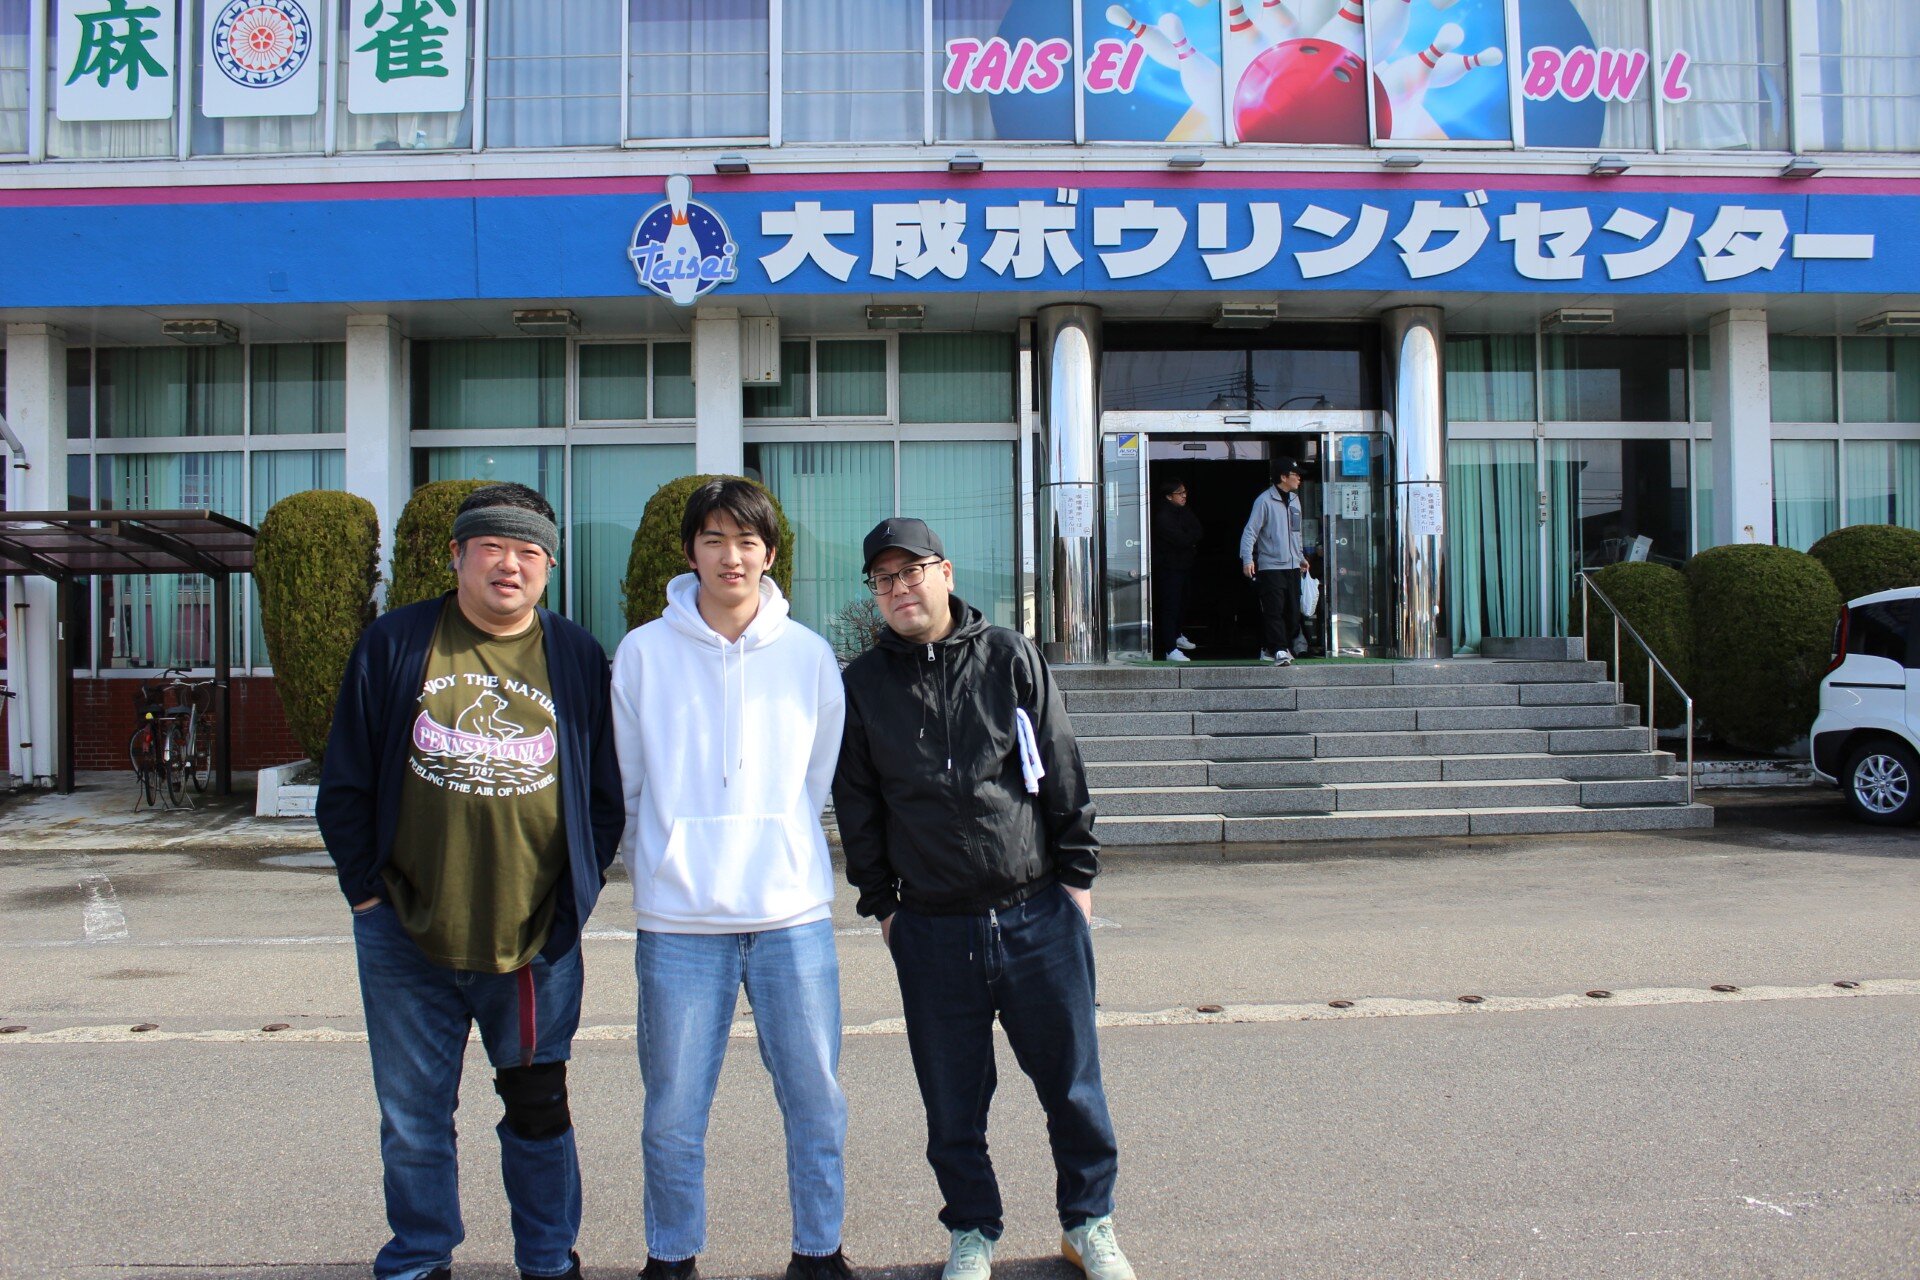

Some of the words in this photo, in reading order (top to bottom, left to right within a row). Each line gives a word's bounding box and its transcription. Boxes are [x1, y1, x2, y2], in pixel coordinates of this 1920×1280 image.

[64, 0, 169, 91] 麻
[354, 0, 457, 83] 雀
[758, 188, 1875, 284] 大成ボウリングセンター
[631, 241, 736, 281] Taisei
[463, 673, 499, 688] THE
[408, 755, 445, 787] FEELING
[447, 780, 471, 793] THE
[474, 786, 494, 797] AIR
[497, 787, 513, 797] OF
[516, 773, 556, 796] NATURE
[468, 765, 495, 778] 1787
